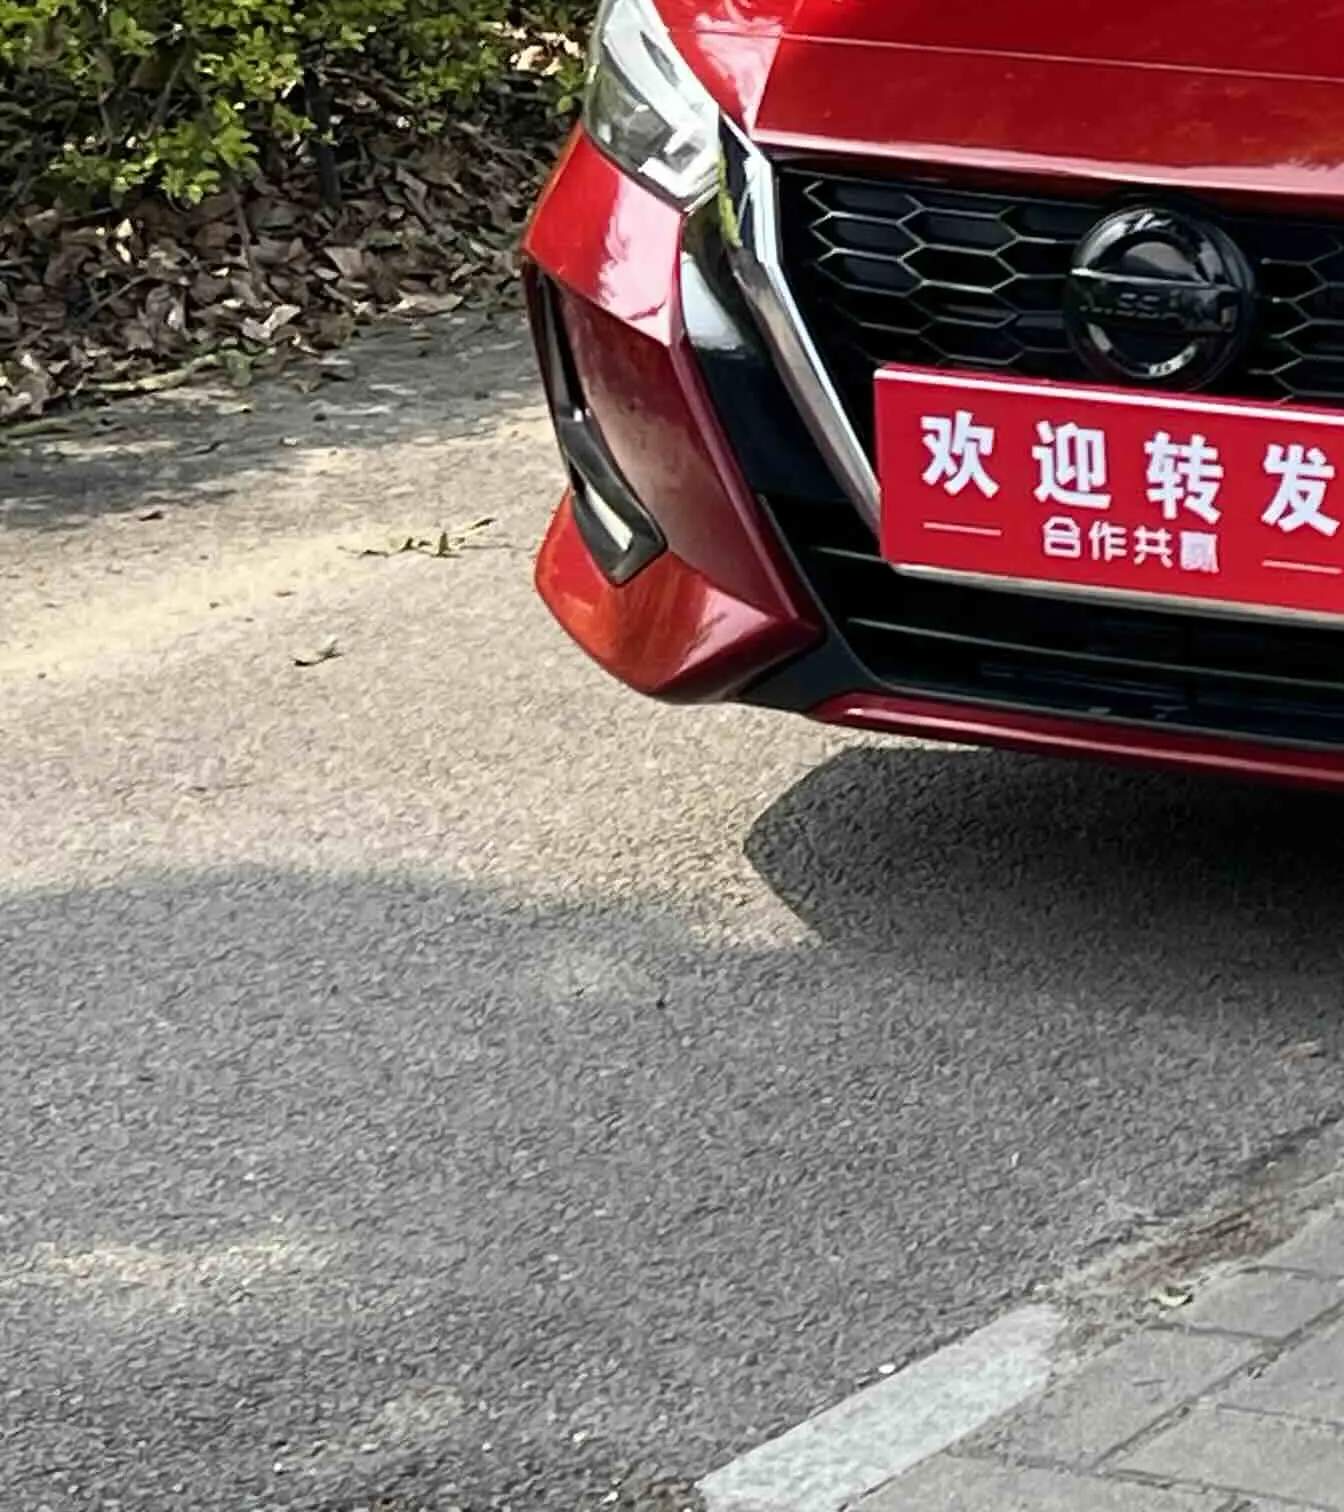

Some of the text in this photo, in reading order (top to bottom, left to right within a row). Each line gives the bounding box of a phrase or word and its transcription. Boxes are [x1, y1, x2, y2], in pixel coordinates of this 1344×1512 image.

[920, 410, 1340, 537] 欢迎转发
[1042, 515, 1220, 574] 合作共赢
